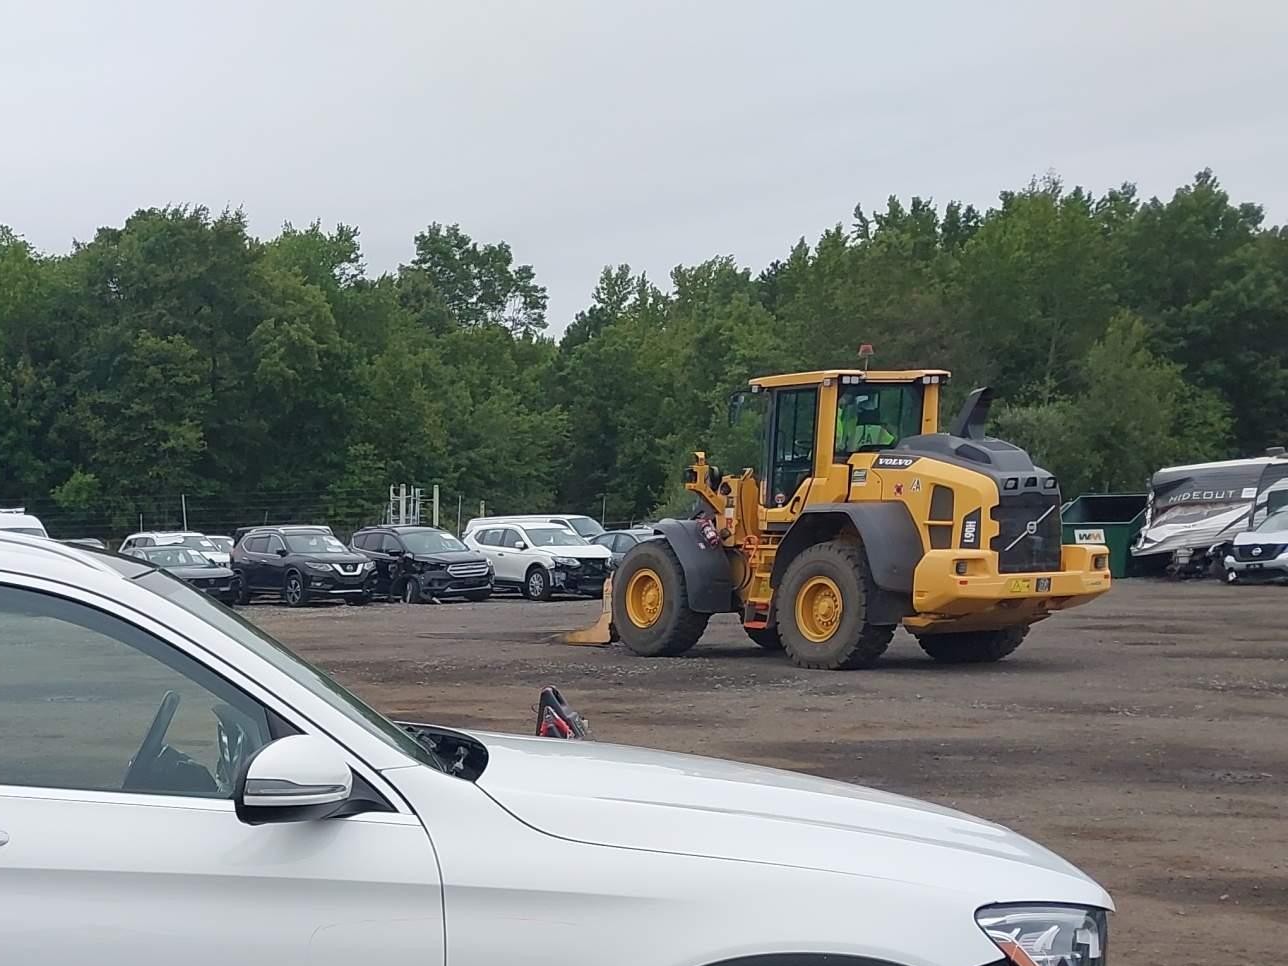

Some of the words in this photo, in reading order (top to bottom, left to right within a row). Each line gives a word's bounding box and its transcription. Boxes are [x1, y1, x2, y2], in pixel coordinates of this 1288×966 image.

[878, 458, 913, 466] VOLVO
[1168, 489, 1236, 504] HIDEOUT
[964, 521, 977, 543] L90H
[1078, 533, 1103, 541] WM
